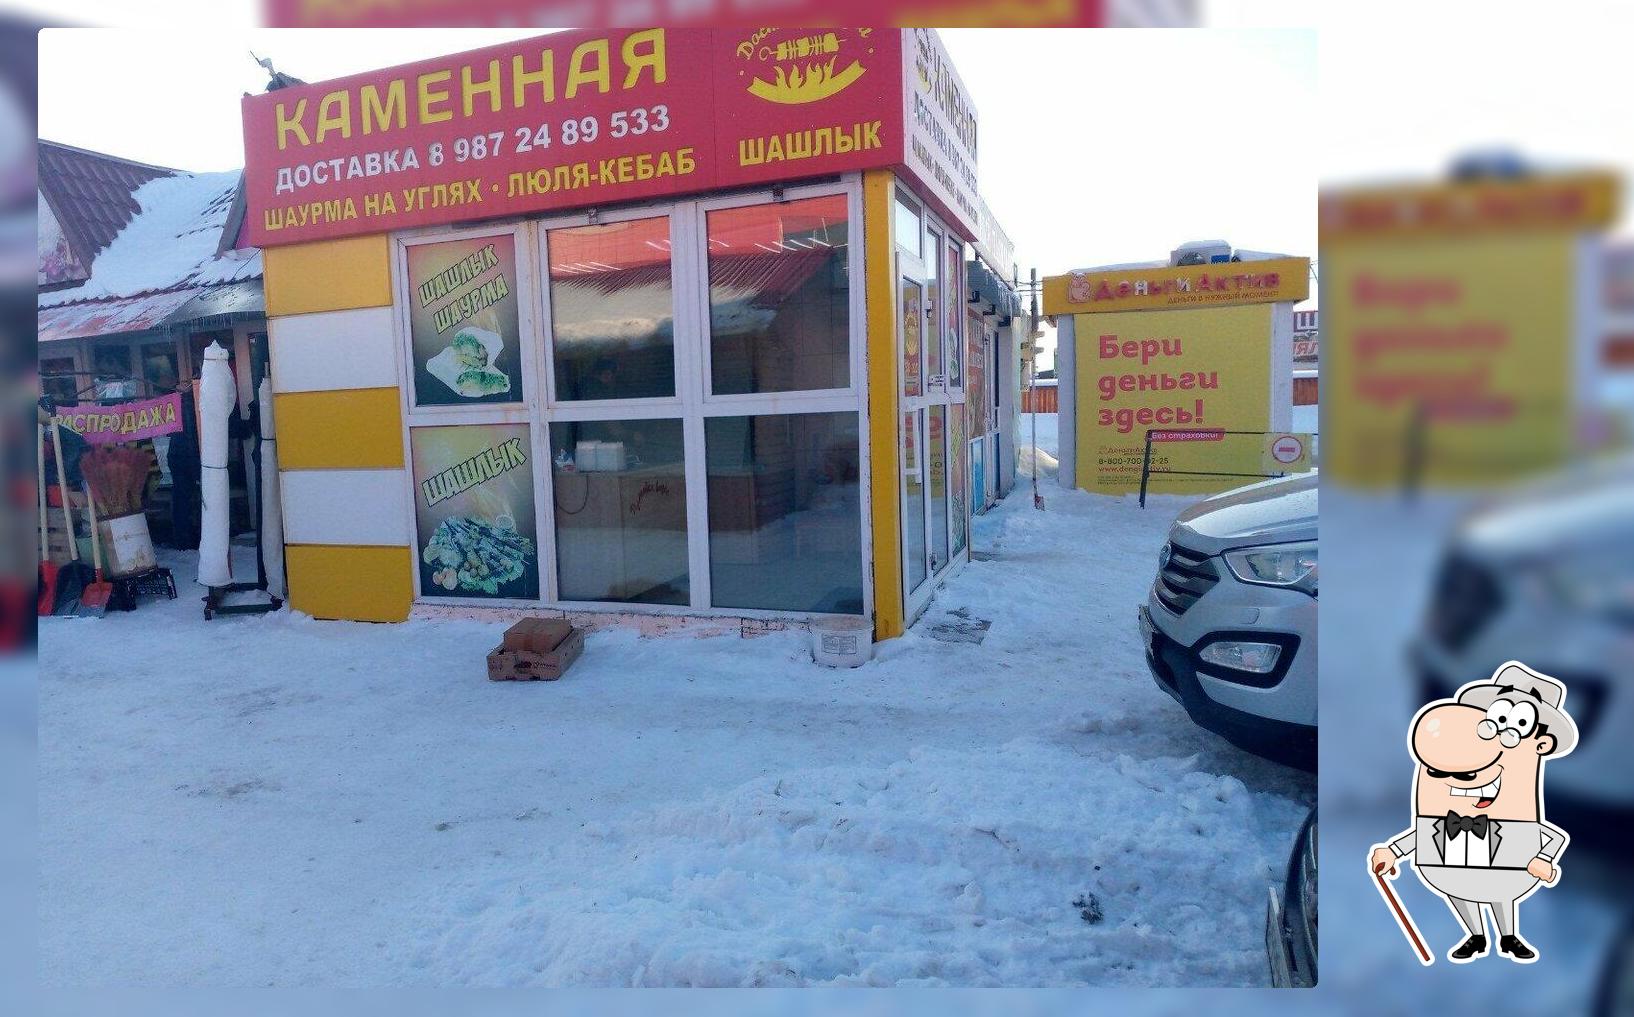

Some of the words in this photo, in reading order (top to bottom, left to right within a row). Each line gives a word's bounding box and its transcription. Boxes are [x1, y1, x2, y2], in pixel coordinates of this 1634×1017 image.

[274, 28, 667, 150] КАМЕННАЯ
[275, 149, 420, 194] ДОСТАВКА
[428, 142, 444, 165] 8
[454, 131, 504, 162] 987
[514, 124, 552, 153] 24
[561, 117, 599, 146] 89
[610, 105, 671, 138] 533
[739, 120, 883, 167] ШАШЛЫК
[264, 197, 359, 231] ШАУРМА
[363, 192, 398, 218] НА
[402, 178, 482, 213] УГЛЯХ
[506, 147, 697, 198] ЛЮЛЯ-КЕБАБ
[418, 244, 500, 308] ШАШЛЫК
[433, 273, 510, 334] ШАУРМА
[1099, 335, 1183, 365] Бери
[1097, 371, 1219, 401] деньги
[1097, 399, 1205, 434] здесь!
[1152, 432, 1166, 440] Без
[422, 438, 527, 508] ШАШЛЫК
